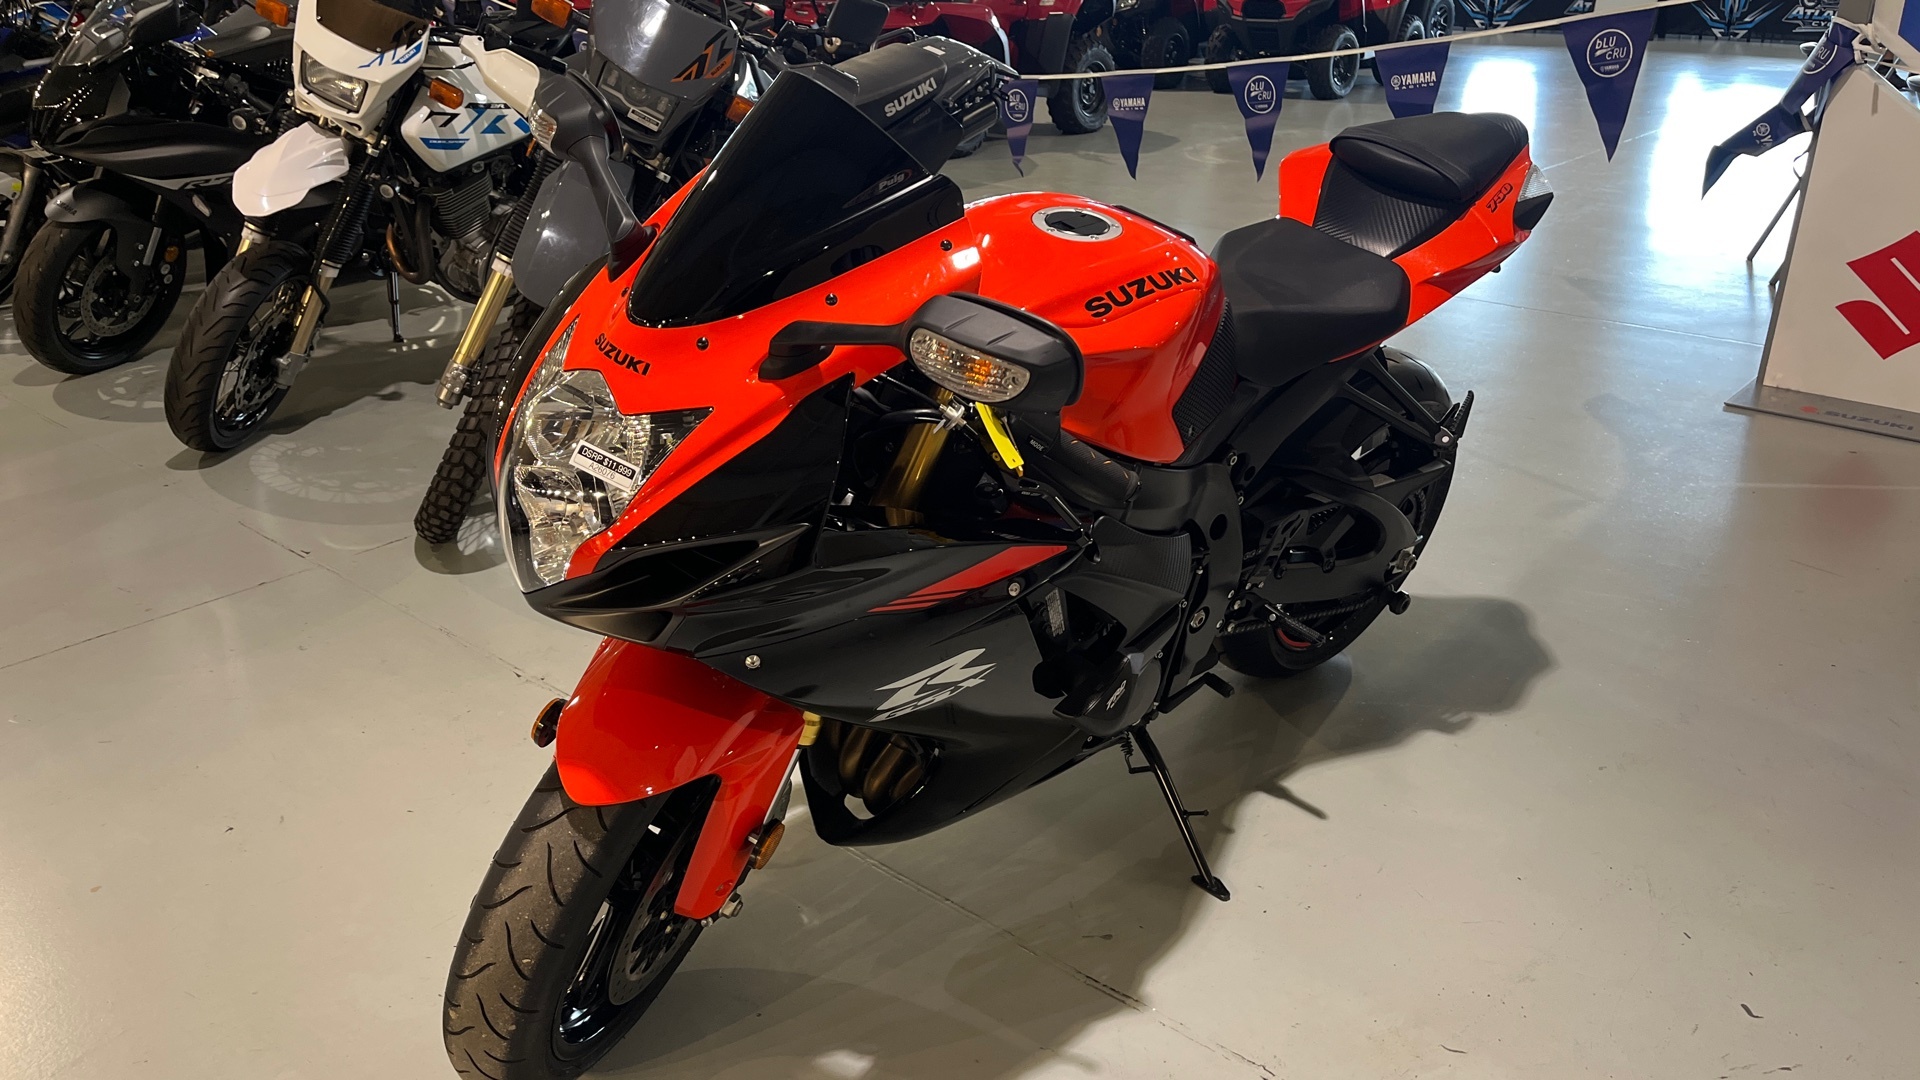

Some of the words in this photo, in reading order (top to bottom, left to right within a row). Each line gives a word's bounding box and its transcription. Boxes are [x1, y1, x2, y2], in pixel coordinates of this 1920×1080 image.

[1788, 6, 1838, 20] ATLA
[1401, 71, 1437, 86] YAMAHA
[884, 77, 937, 118] SUZUKI
[1120, 97, 1146, 107] YAMAHA
[1486, 182, 1514, 214] 750
[1084, 266, 1200, 319] SUZUKI
[594, 332, 651, 377] SUZUKI
[1824, 410, 1914, 431] SUZUKI
[1029, 439, 1045, 452] MODE
[581, 447, 604, 462] DSRP
[602, 457, 633, 477] $11,999
